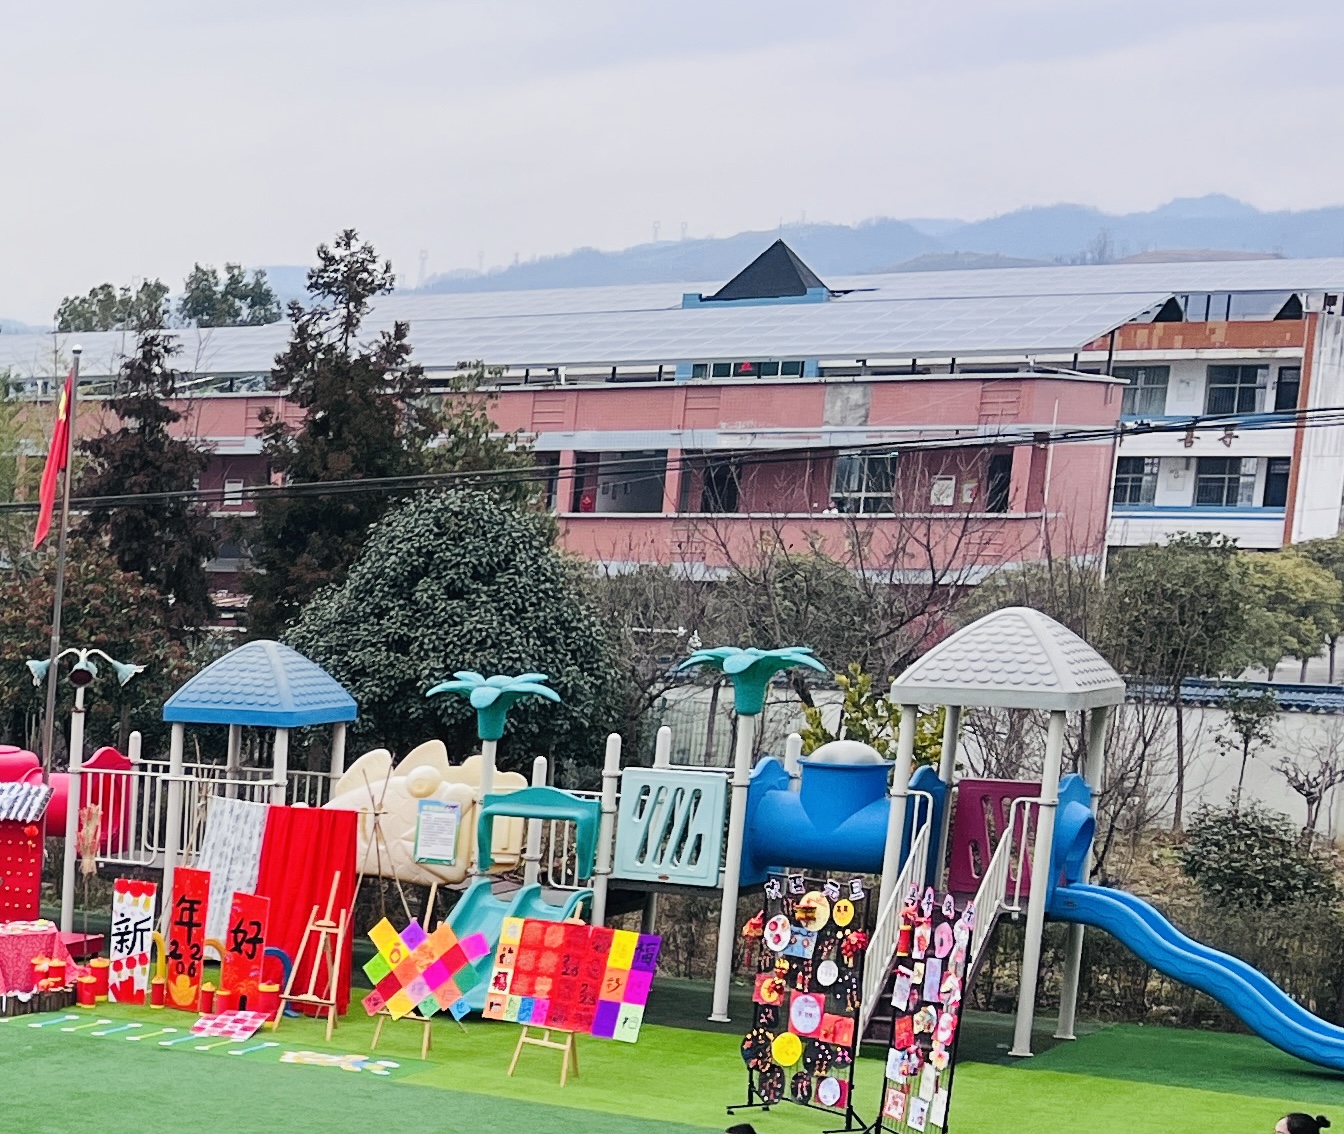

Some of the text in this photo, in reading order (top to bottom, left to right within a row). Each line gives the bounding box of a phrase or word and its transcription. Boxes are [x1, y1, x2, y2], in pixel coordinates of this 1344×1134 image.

[112, 895, 264, 959] 新 年 好
